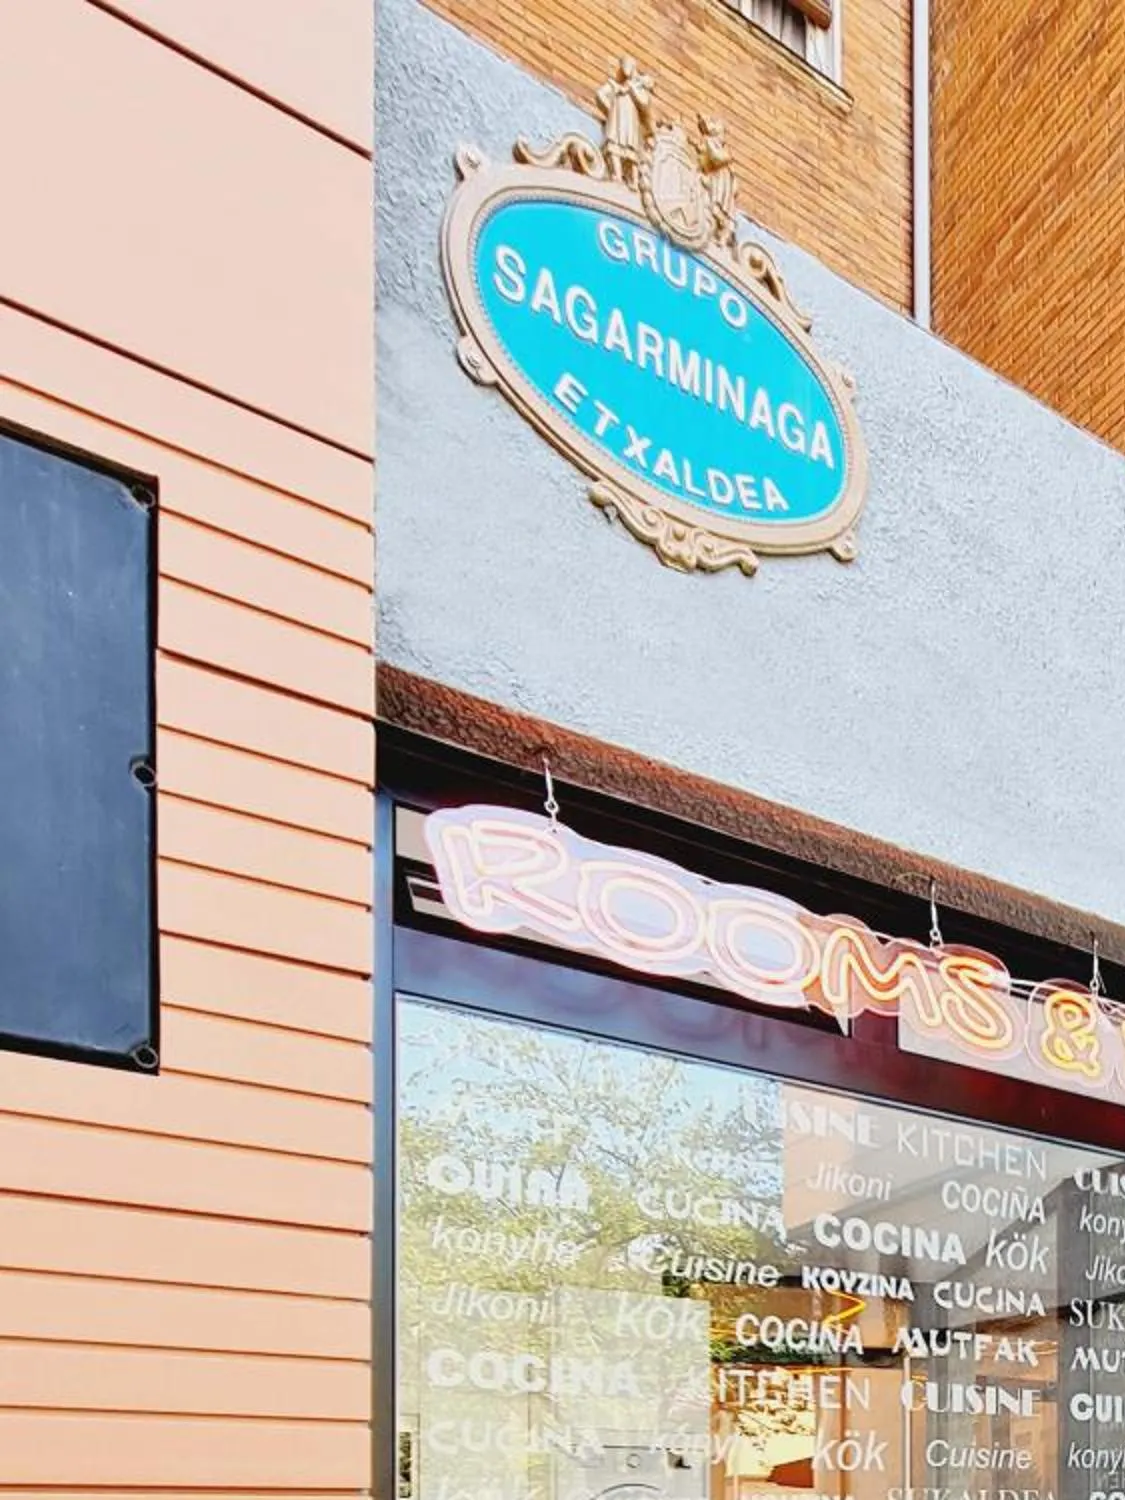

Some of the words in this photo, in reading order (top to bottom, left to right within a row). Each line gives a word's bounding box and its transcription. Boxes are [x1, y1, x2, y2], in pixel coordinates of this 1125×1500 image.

[598, 220, 748, 329] GRUPO
[493, 244, 835, 470] SAGARMINAGA
[553, 372, 790, 513] ETXALDEA
[441, 820, 1013, 1050] ROOMS
[1041, 989, 1100, 1080] &
[896, 1120, 1047, 1182] KITCHEN
[813, 1213, 967, 1266] COCINA
[933, 1280, 1046, 1318] CUCINA
[892, 1326, 1040, 1368] MUTFAK
[901, 1379, 1043, 1418] CUISINE
[926, 1437, 1034, 1472] Cuisine
